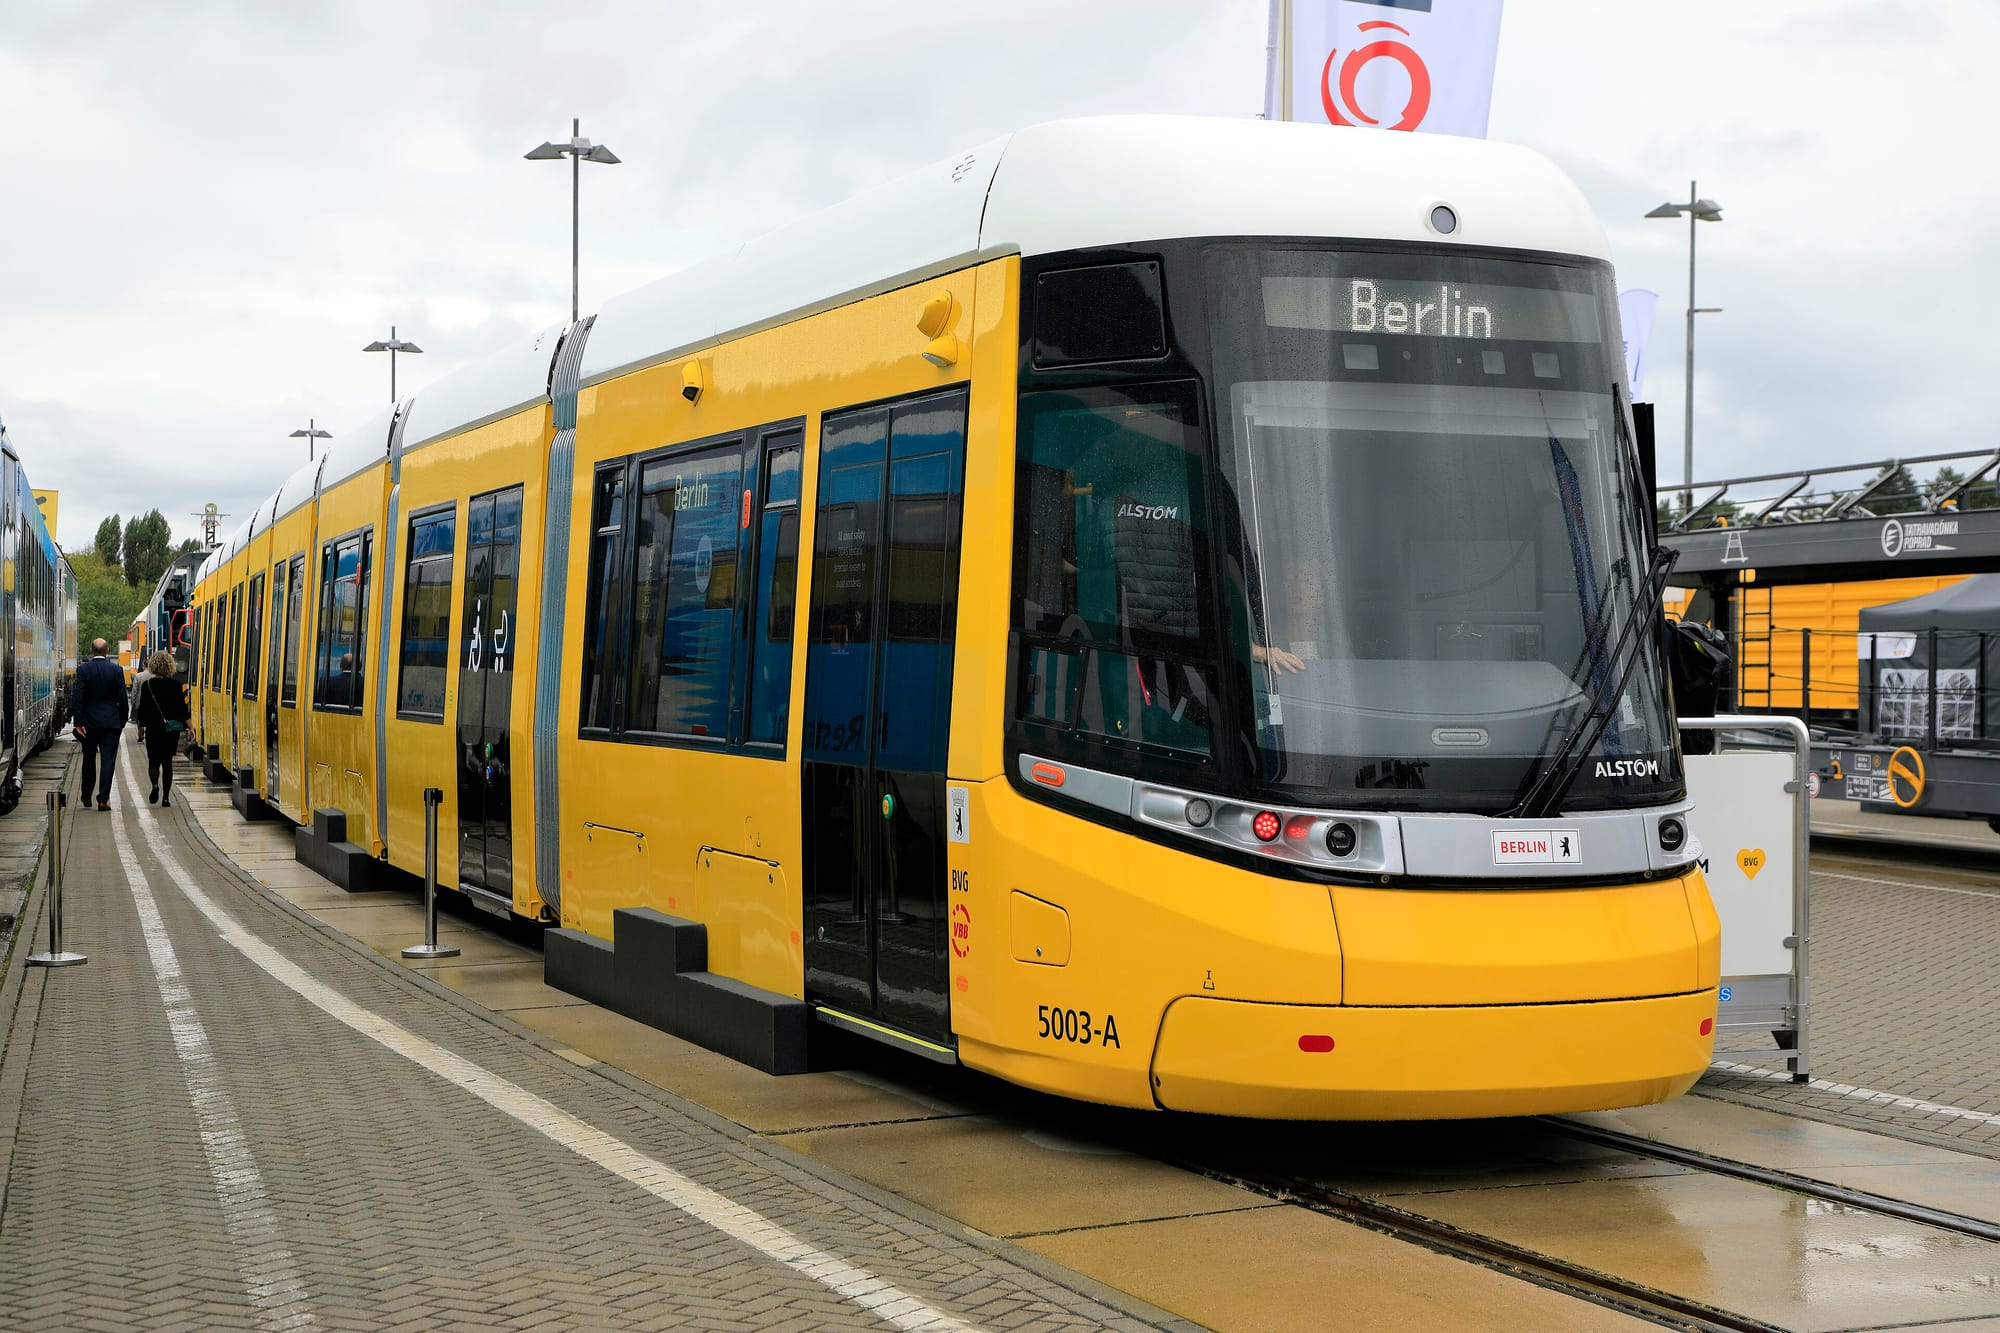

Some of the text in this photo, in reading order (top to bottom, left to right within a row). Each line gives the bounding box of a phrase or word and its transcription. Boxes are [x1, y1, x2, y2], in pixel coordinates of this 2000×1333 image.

[1350, 279, 1492, 338] Berlin
[674, 472, 709, 510] Berlin
[1117, 503, 1178, 520] ALSTOM
[1904, 536, 1932, 549] POPRAD
[1595, 758, 1659, 778] ALSTOM
[1500, 841, 1547, 855] BERLIN
[1744, 857, 1758, 866] BVG
[952, 869, 969, 892] BVG
[953, 921, 969, 939] VBB
[1038, 1005, 1121, 1050] 5003-A
